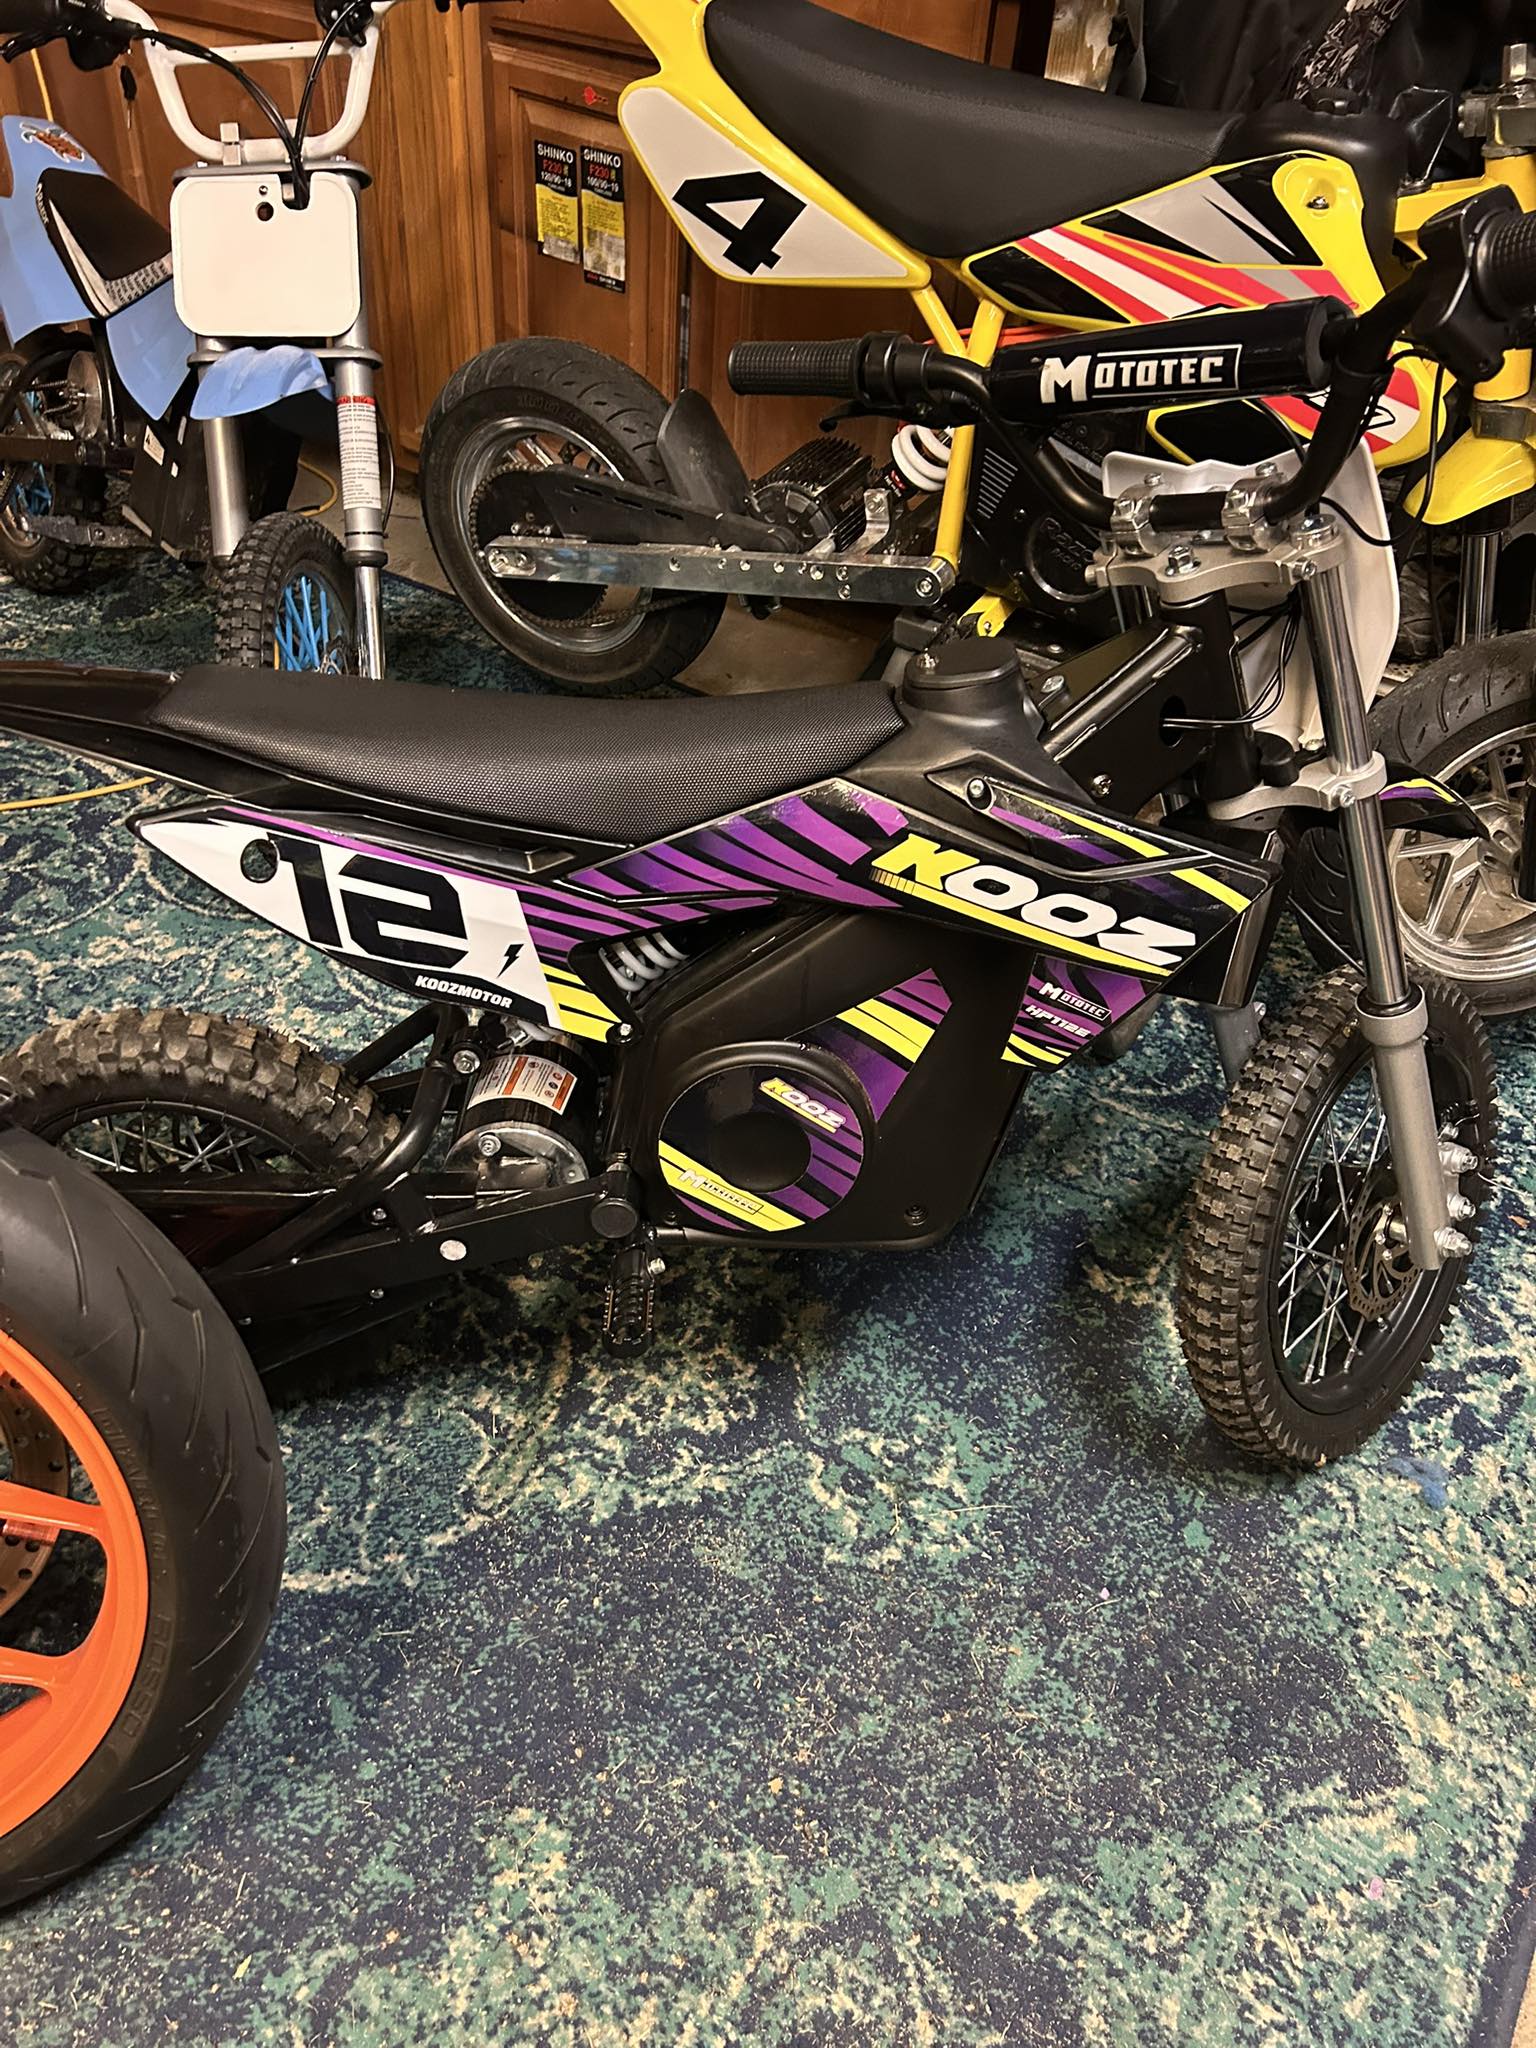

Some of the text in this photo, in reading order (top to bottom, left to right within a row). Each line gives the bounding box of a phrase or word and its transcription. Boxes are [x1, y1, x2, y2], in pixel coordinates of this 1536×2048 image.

[537, 143, 574, 164] SHINKO
[583, 148, 621, 168] SHINKO
[672, 171, 807, 275] 4
[1039, 354, 1225, 404] MOTOTEC
[266, 831, 470, 970] 12
[871, 833, 1196, 966] KOOZ
[414, 974, 513, 1008] KOOZMOTOR
[1038, 982, 1107, 1018] MOTOTEC
[760, 1076, 847, 1129] KOOZ
